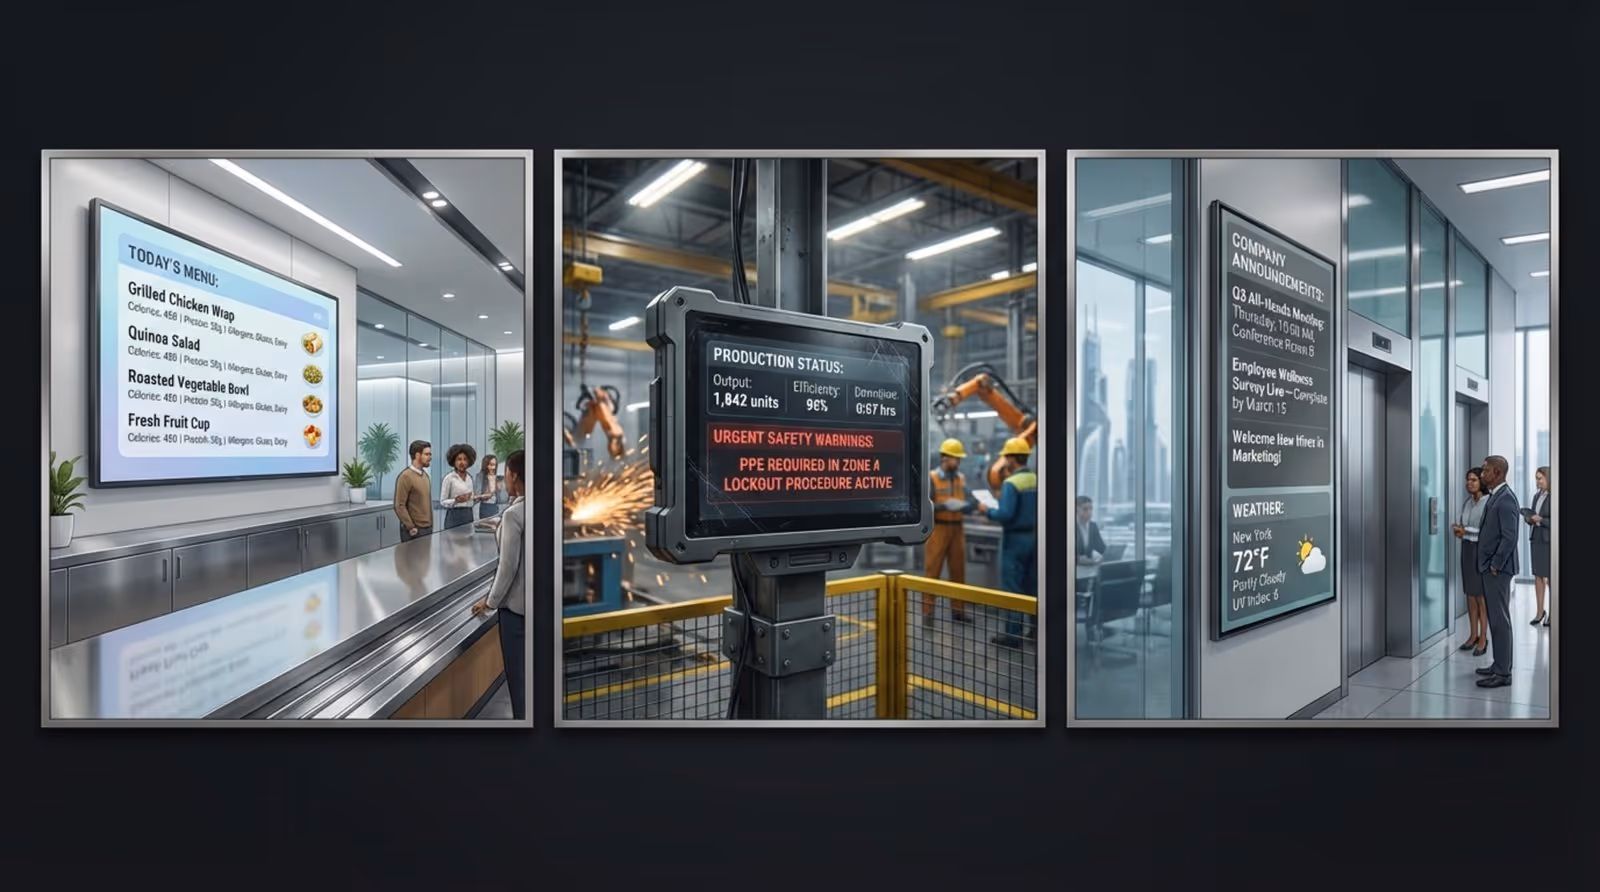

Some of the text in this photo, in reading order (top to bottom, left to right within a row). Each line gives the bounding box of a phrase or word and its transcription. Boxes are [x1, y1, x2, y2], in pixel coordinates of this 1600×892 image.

[128, 245, 219, 288] TODAY'S MENU:
[128, 281, 166, 303] Grilled
[169, 292, 209, 316] Chicken
[212, 305, 235, 324] Wrap
[128, 325, 200, 352] Quinoa Salad
[713, 347, 844, 374] PRODUCTION STATUS:
[128, 369, 174, 387] Roasted
[177, 375, 226, 394] Vegetable
[713, 373, 752, 389] Output:
[713, 392, 779, 409] 1,842 units
[1232, 396, 1244, 412] by
[880, 404, 896, 416] hrs
[128, 412, 210, 432] Fresh Fruit Cup
[713, 429, 764, 444] URGENT
[768, 431, 812, 446] SAFETY
[1232, 429, 1275, 445] Welcome
[740, 457, 764, 472] PPE
[768, 457, 825, 472] REQUIRED
[828, 458, 839, 471] IN
[843, 459, 870, 472] ZONE
[724, 477, 782, 492] LOCKOUT
[855, 476, 892, 489] ACTIVE
[1232, 501, 1284, 518] WEATHER:
[1233, 531, 1252, 544] New
